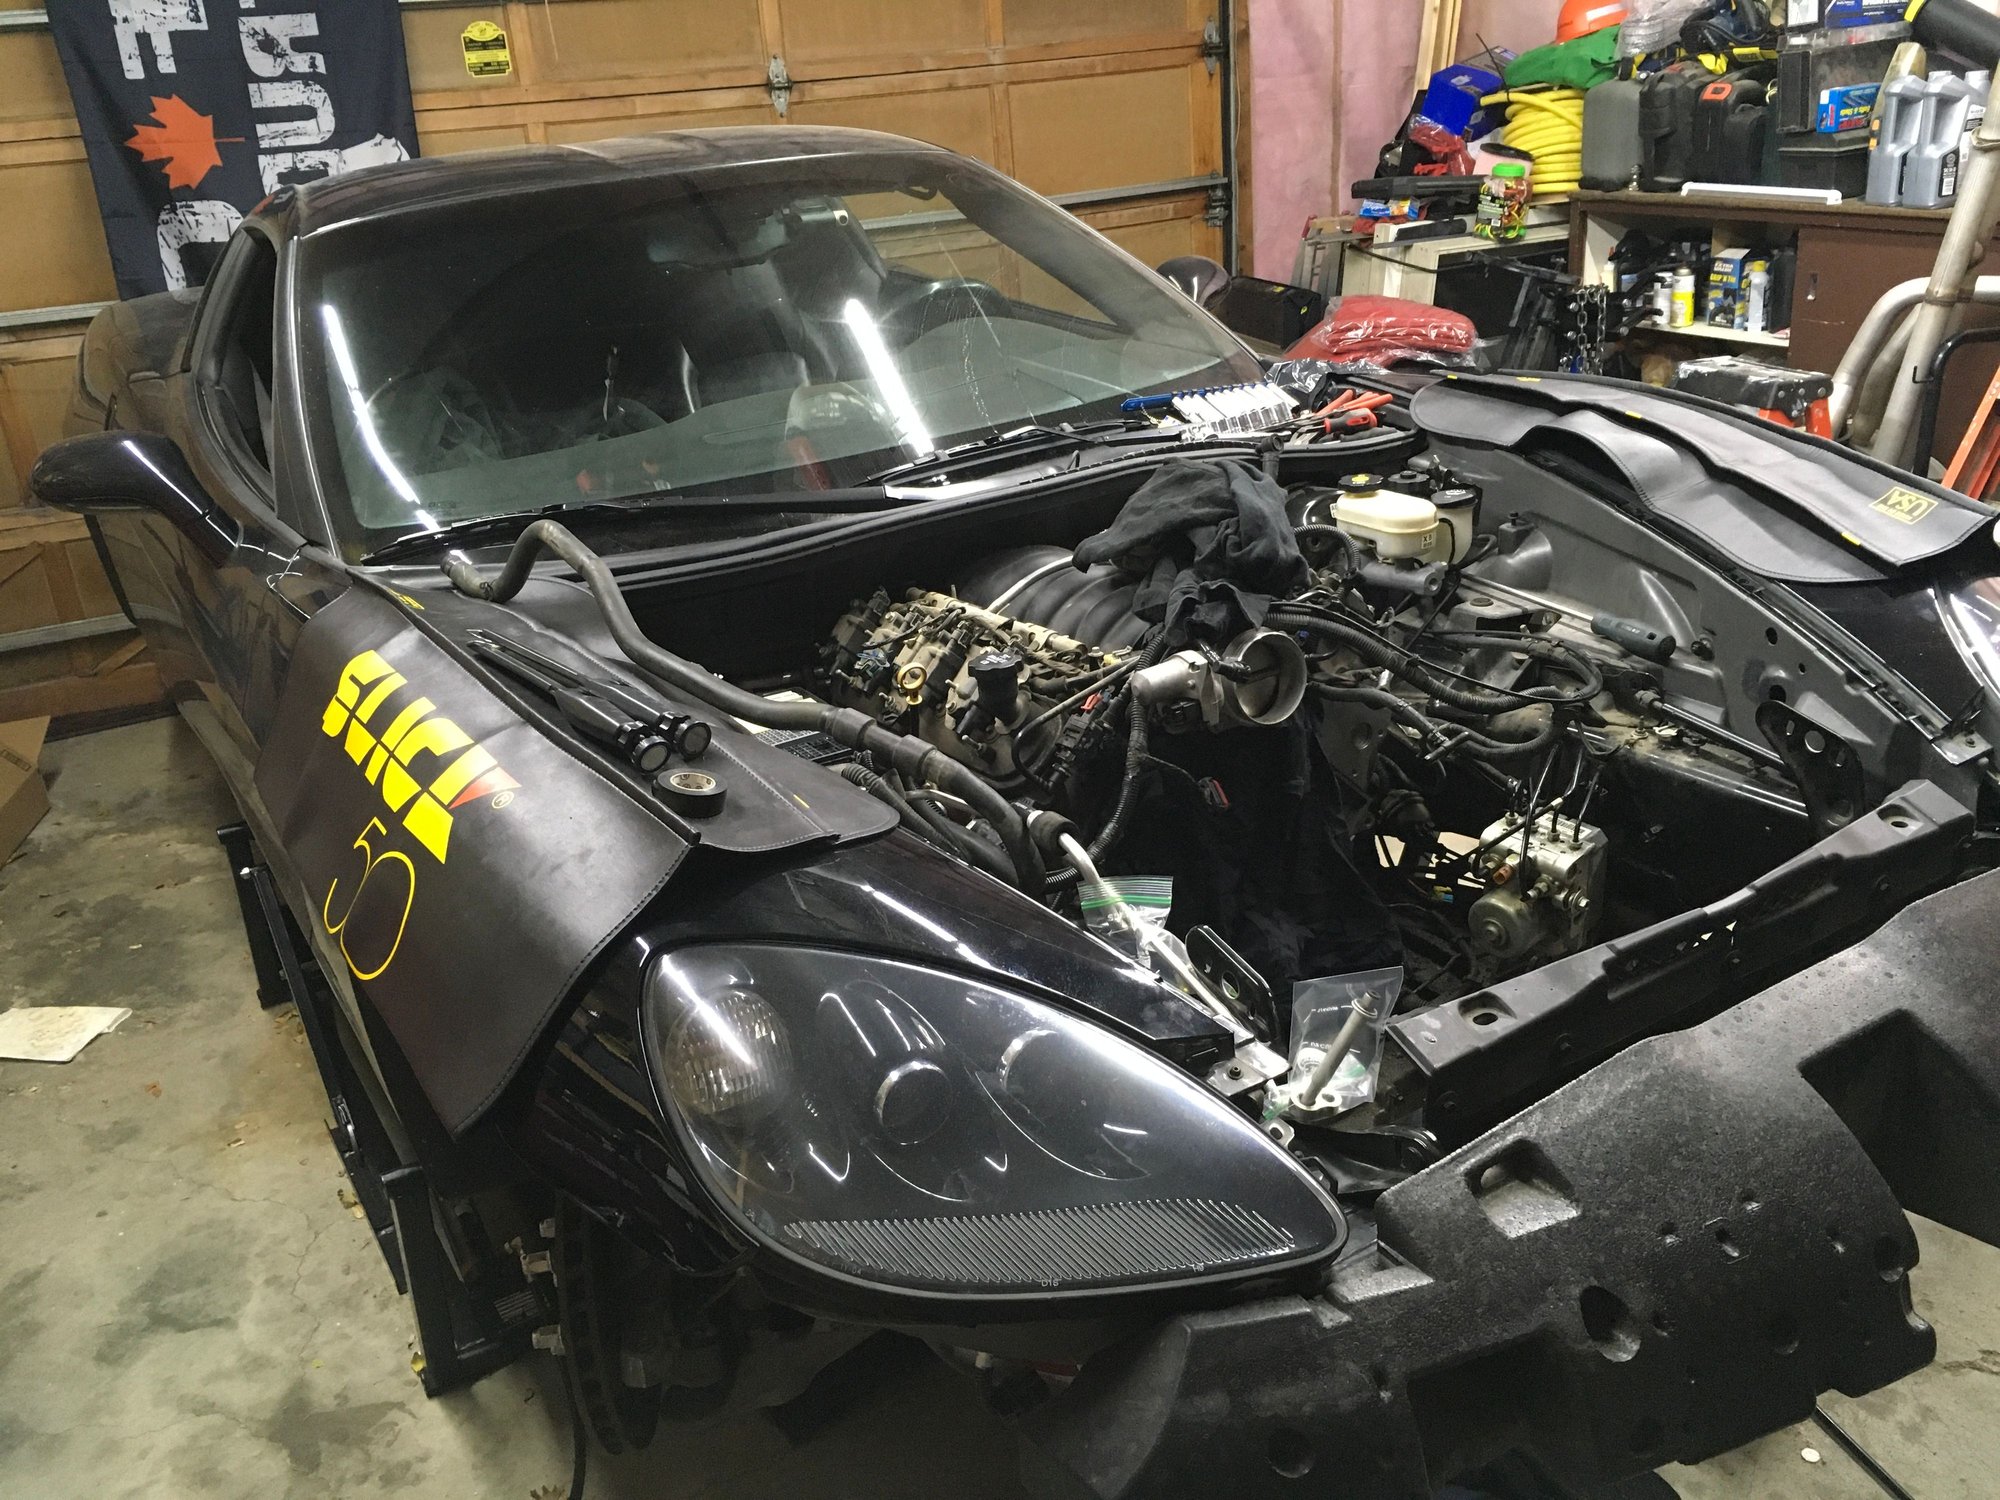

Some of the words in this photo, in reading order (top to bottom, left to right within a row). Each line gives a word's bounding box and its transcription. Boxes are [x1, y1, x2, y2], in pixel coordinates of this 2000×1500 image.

[1888, 491, 1928, 515] USA
[322, 650, 521, 864] SLICK
[324, 817, 416, 981] 50
